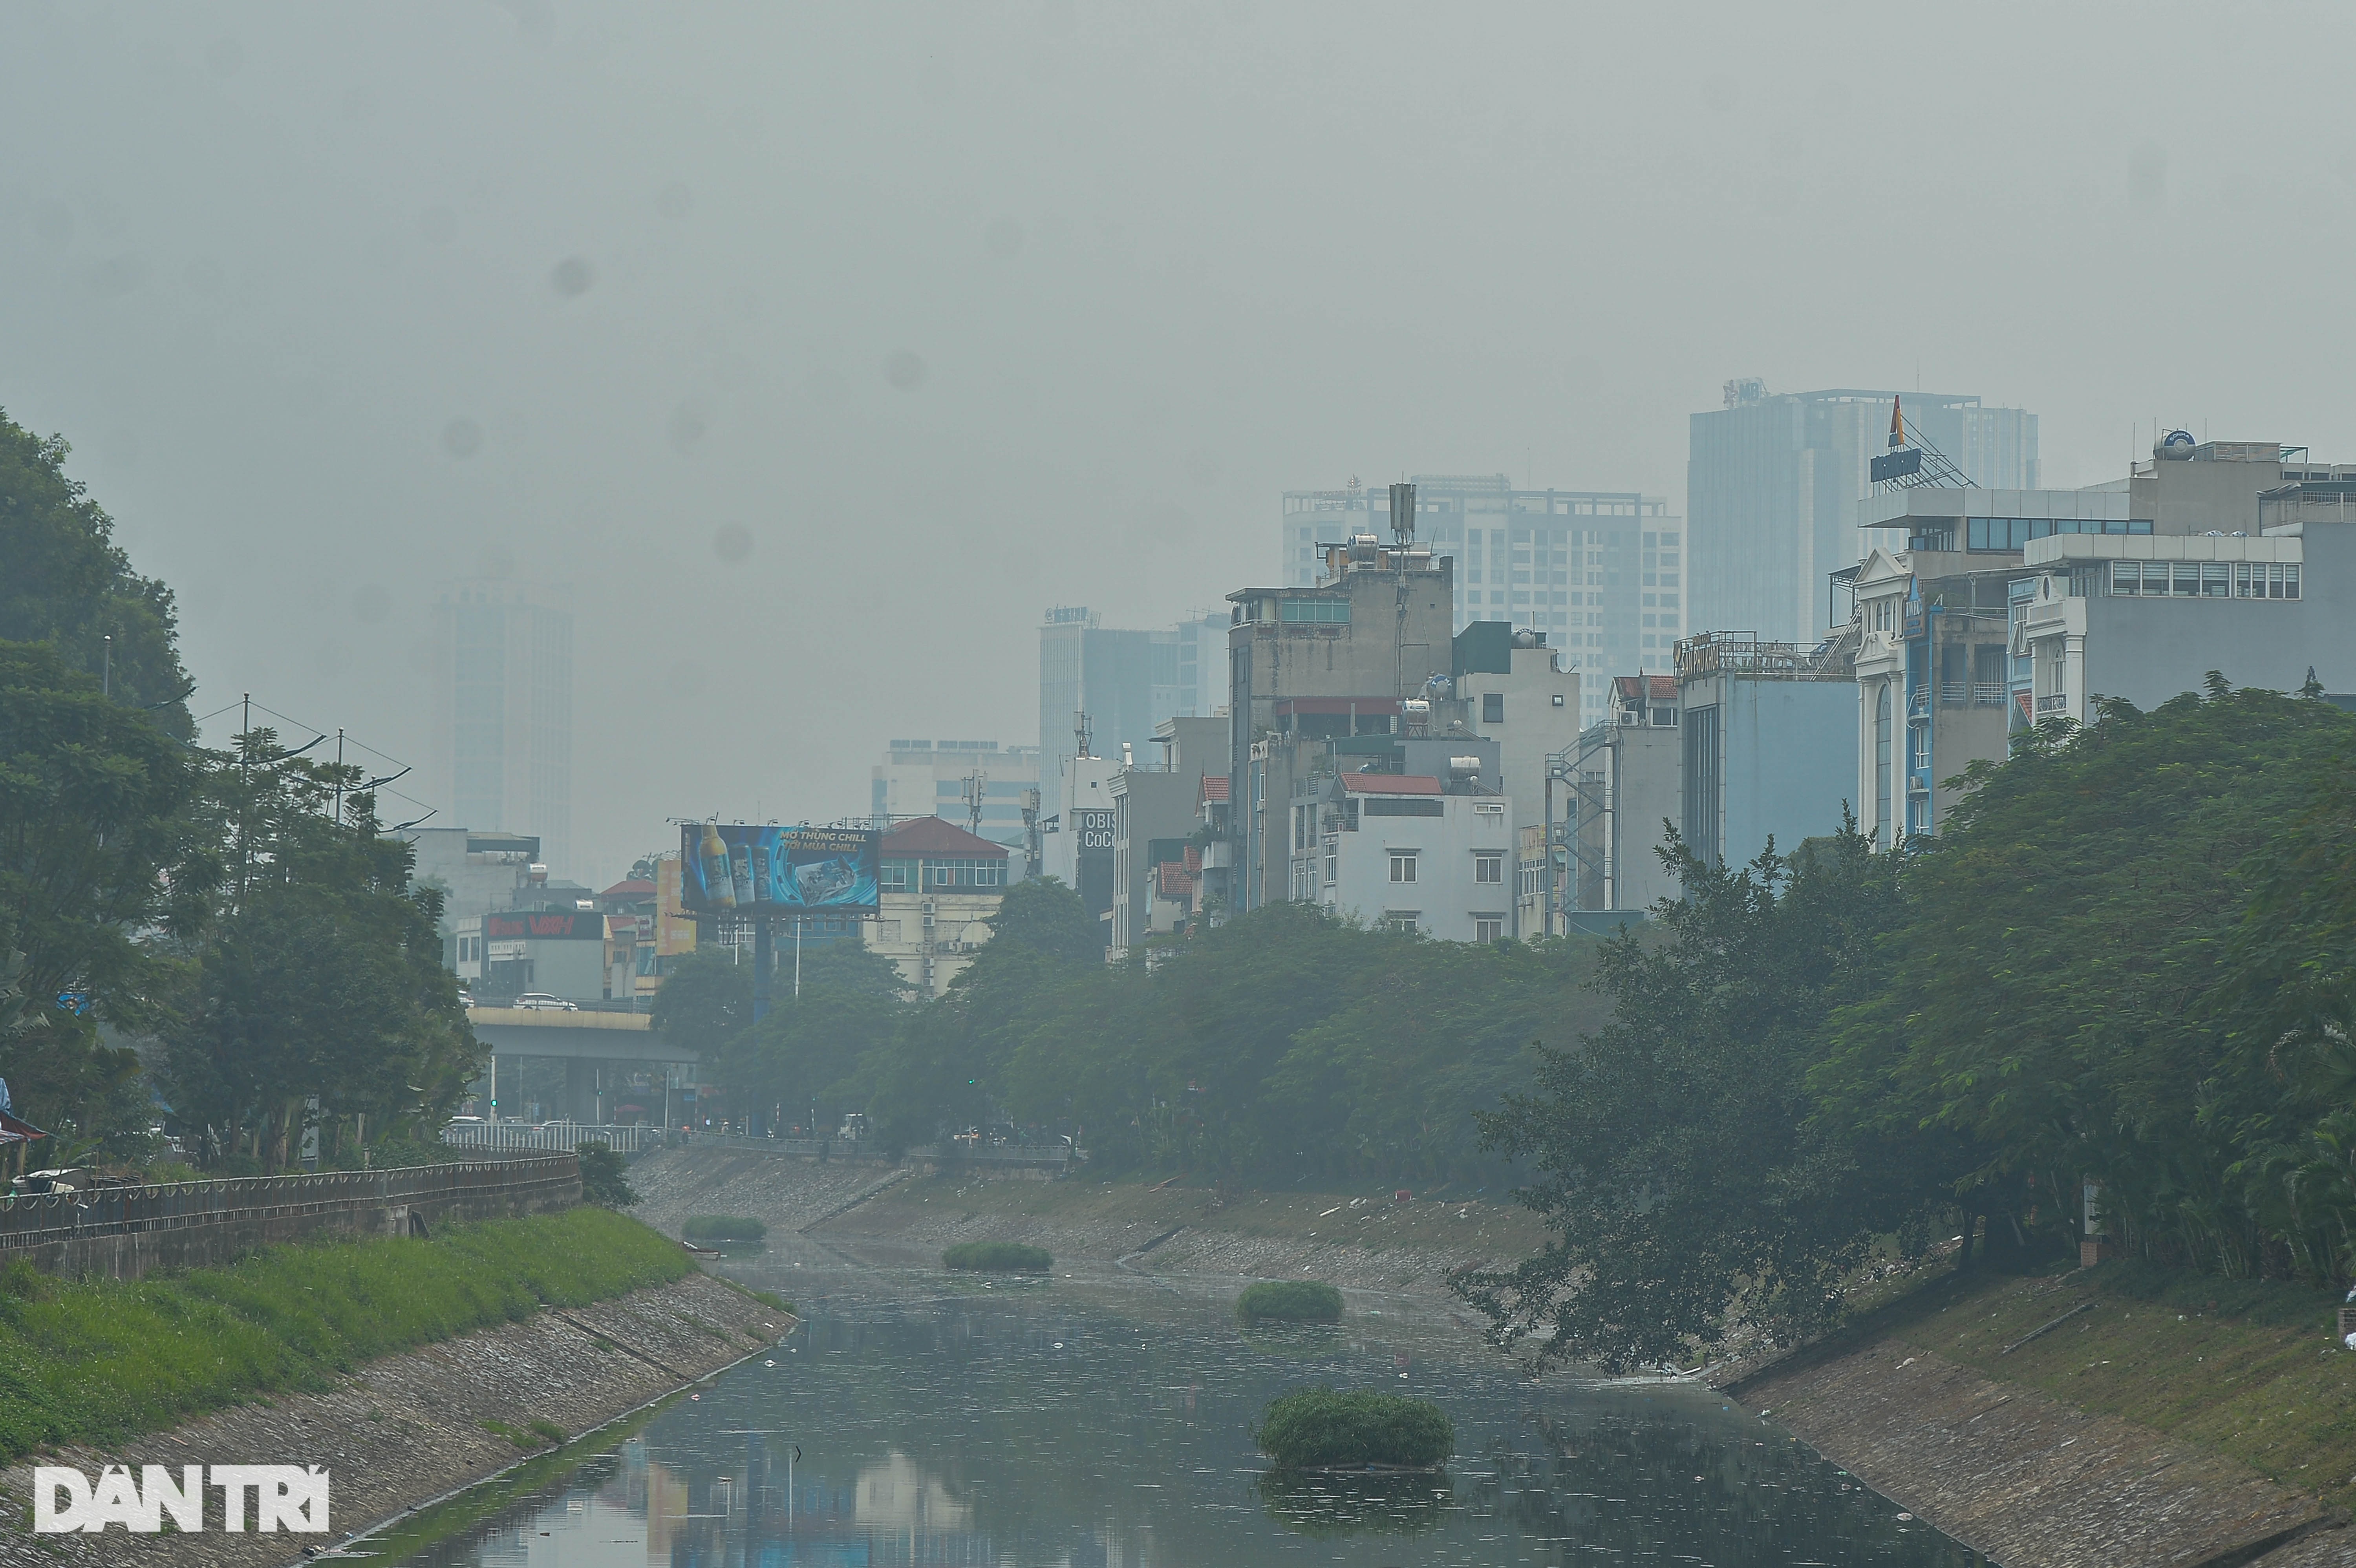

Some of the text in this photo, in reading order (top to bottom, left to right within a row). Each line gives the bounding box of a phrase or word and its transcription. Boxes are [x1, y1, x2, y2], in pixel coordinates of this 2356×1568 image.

[801, 829, 836, 841] THÙNG
[838, 834, 866, 842] CHILL
[803, 841, 826, 851] MÙA
[829, 843, 858, 852] CHILL
